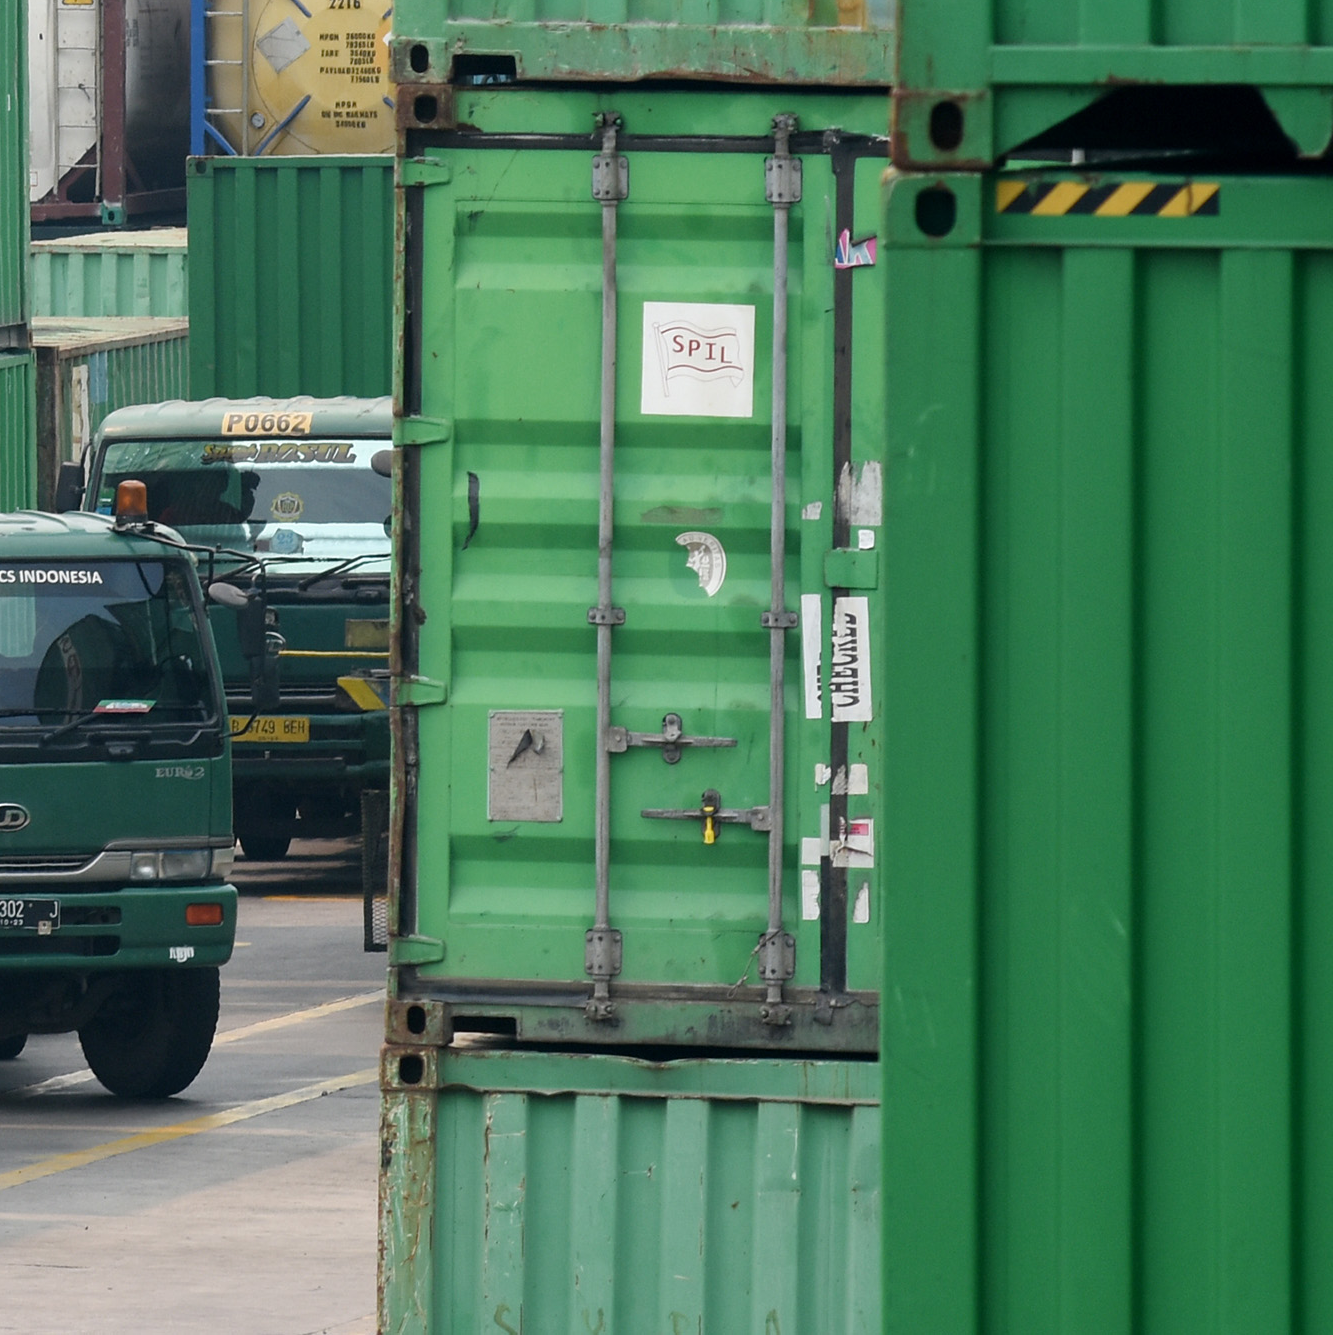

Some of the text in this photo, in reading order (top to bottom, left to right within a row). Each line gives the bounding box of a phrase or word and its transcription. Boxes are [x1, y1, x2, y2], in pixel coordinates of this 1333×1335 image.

[672, 335, 733, 364] SPIL
[19, 570, 103, 584] INDONESIA
[248, 719, 275, 734] 749
[49, 900, 59, 919] J
